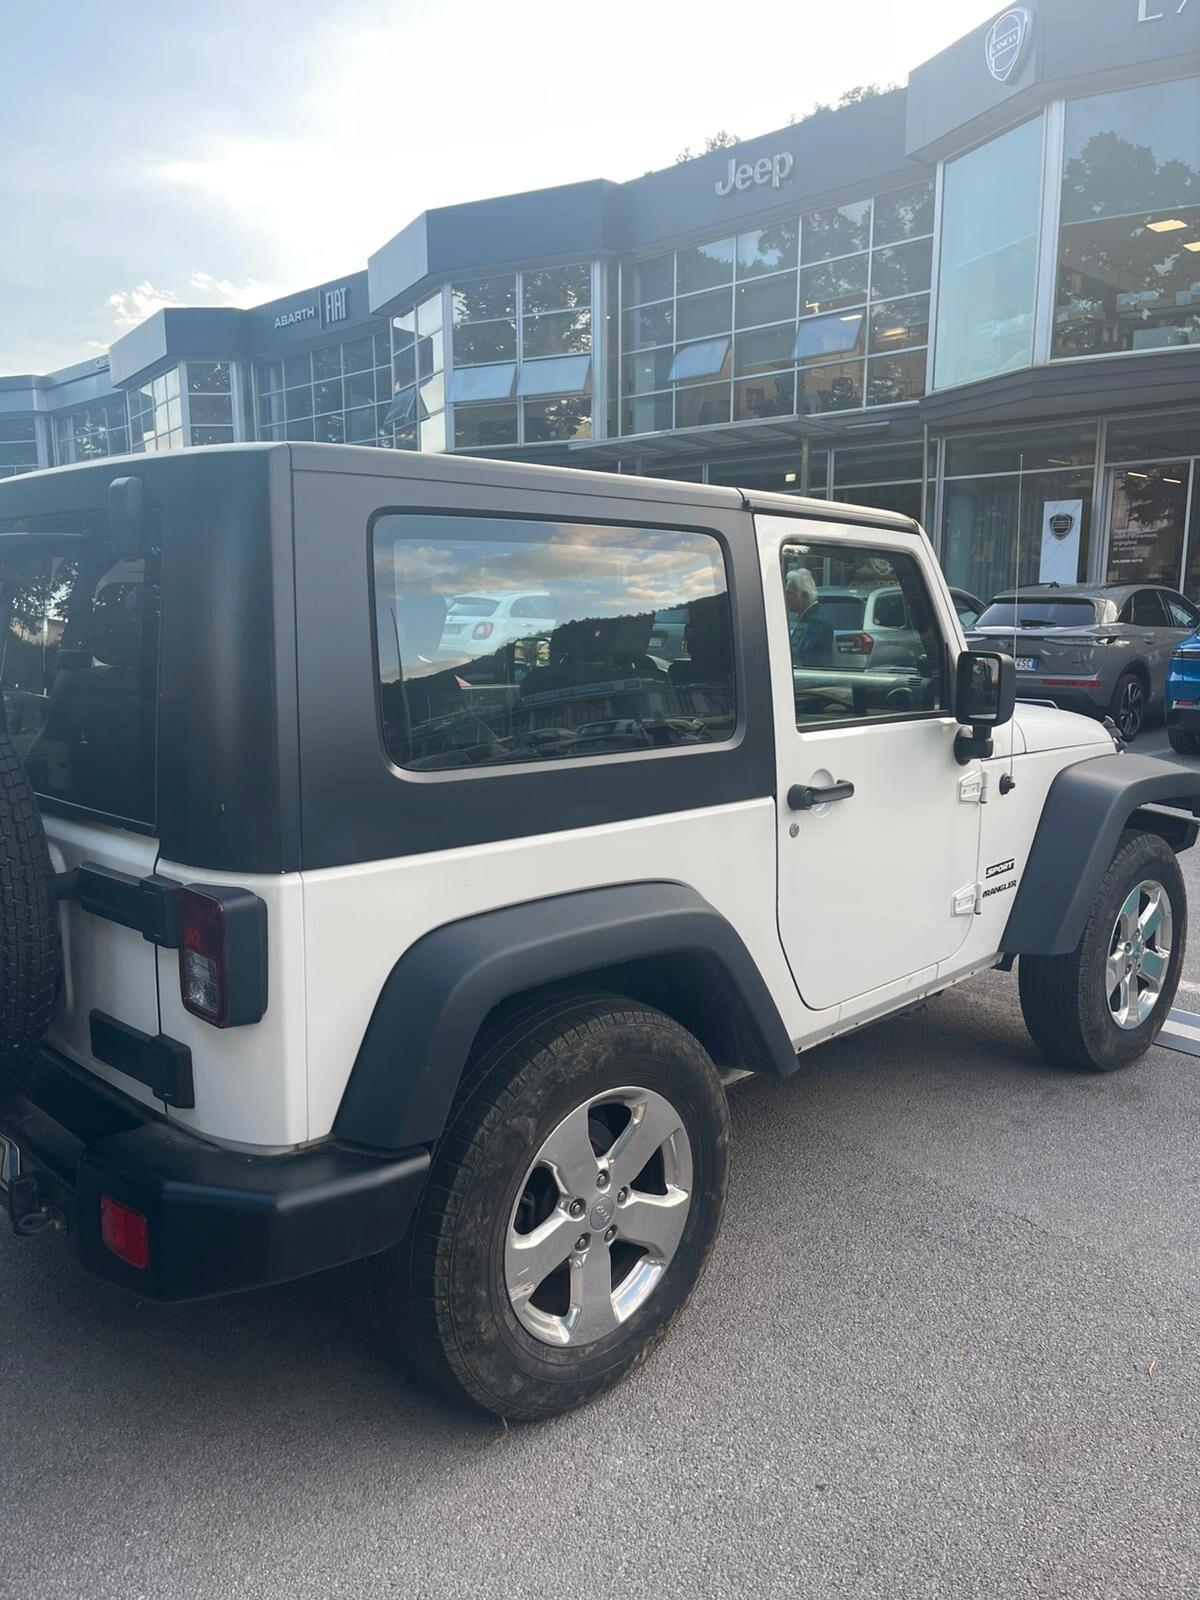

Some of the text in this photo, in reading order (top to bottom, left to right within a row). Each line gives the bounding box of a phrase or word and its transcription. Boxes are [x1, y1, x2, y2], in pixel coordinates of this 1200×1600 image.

[714, 151, 794, 196] Jeep
[274, 306, 315, 329] ABARTH
[325, 286, 347, 323] FIAT
[986, 861, 1015, 877] SPORT
